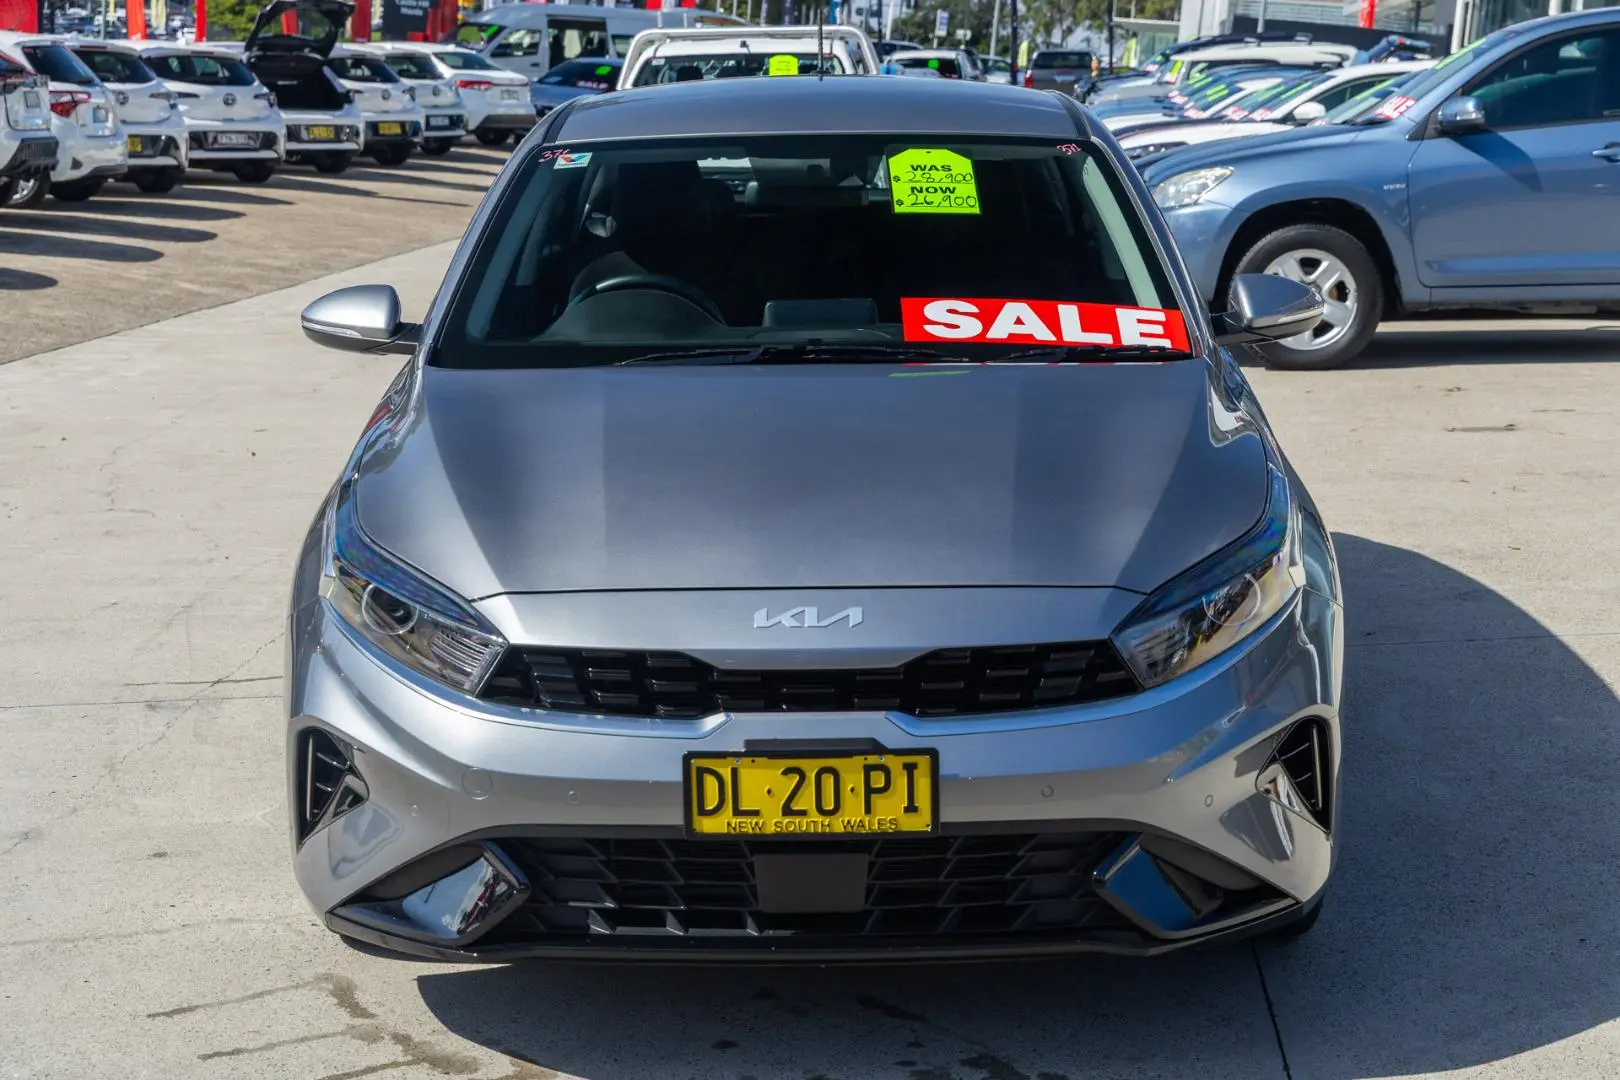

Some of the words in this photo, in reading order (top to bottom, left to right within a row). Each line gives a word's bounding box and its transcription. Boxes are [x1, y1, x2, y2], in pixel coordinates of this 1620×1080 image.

[910, 186, 956, 194] NOW
[907, 194, 977, 208] 26,900
[923, 299, 1172, 348] SALE
[696, 765, 760, 817] DL
[781, 766, 840, 817] 20
[863, 762, 918, 815] PI
[725, 819, 763, 832] NEW
[773, 819, 832, 832] SOUTH
[840, 817, 898, 831] WALES
